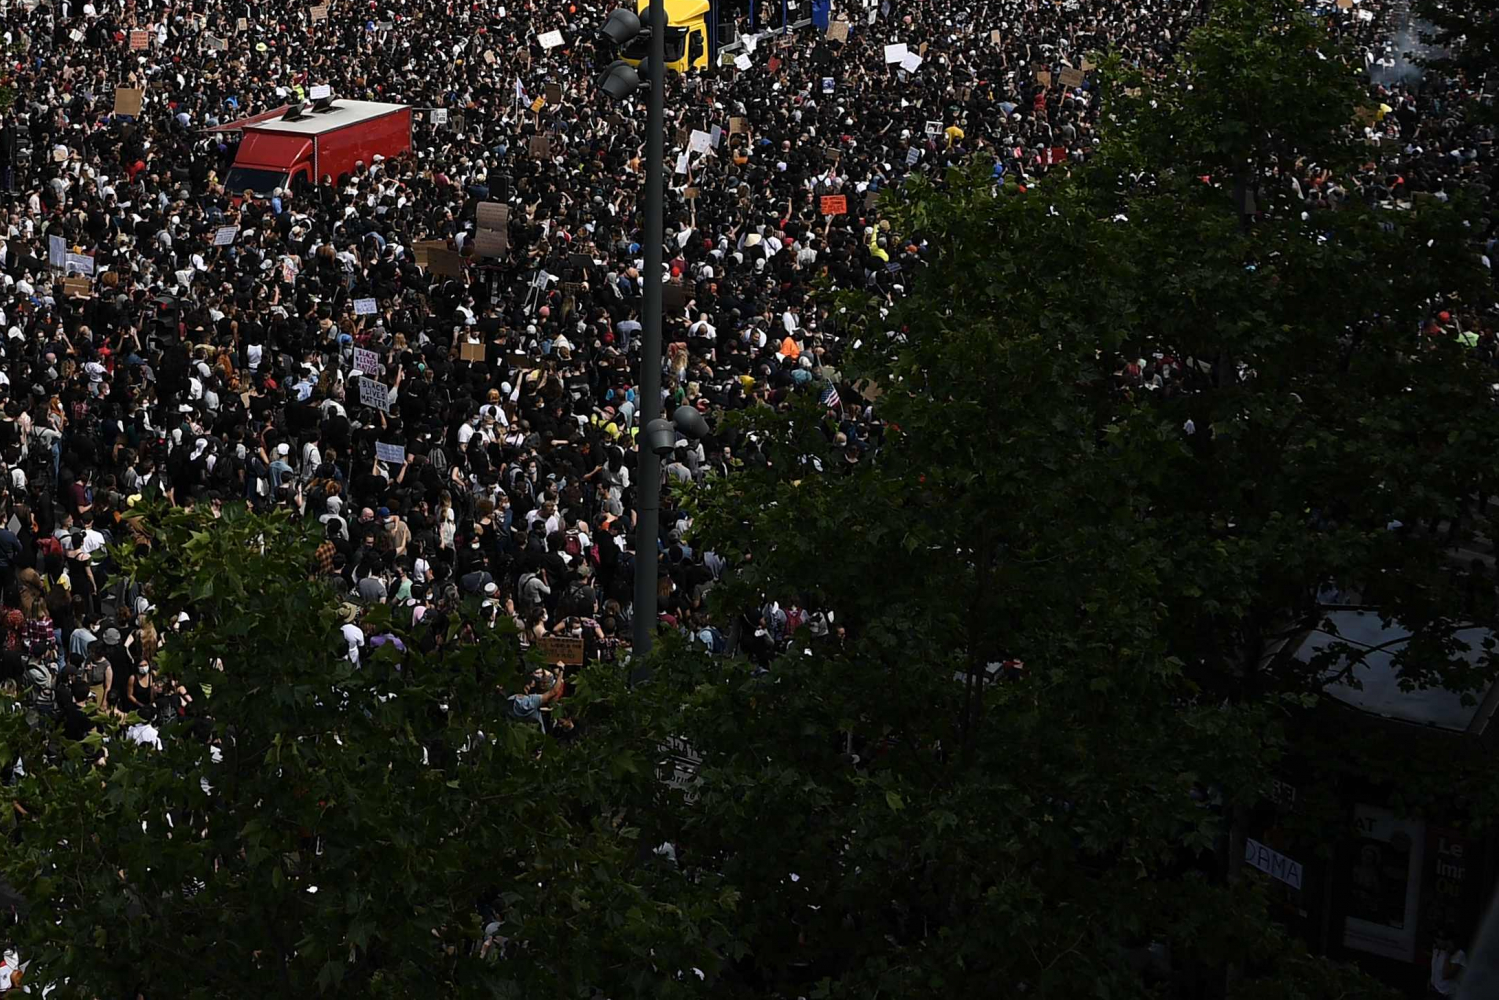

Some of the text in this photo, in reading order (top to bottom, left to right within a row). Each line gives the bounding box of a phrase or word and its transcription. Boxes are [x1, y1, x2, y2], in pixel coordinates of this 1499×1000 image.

[358, 349, 377, 361] BLACK
[362, 380, 386, 394] BLACK
[365, 389, 386, 400] LIVES
[361, 393, 387, 410] MATTER
